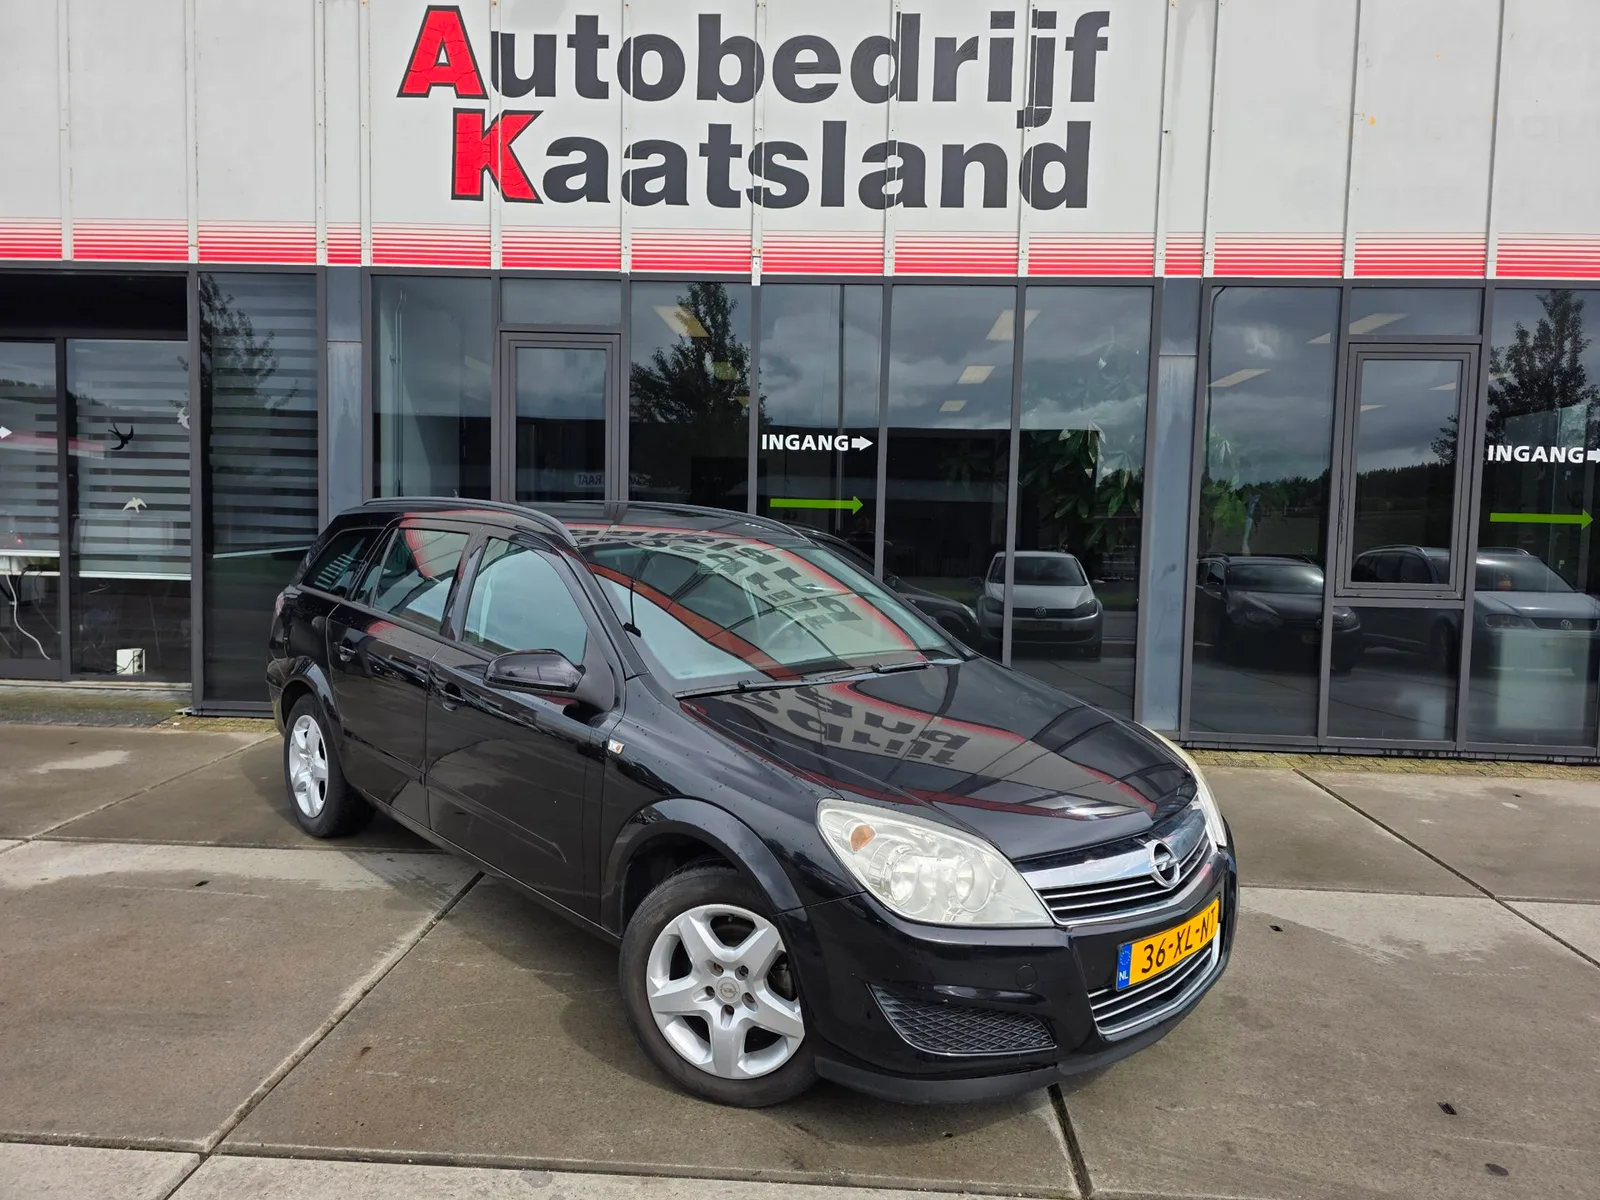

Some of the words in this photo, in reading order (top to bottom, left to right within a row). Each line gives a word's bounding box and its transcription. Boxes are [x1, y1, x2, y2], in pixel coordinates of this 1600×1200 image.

[396, 5, 1110, 128] Autobedrijf
[450, 108, 1091, 210] Kaatsland
[761, 434, 849, 451] INGANG
[1487, 445, 1584, 463] INGANG
[1141, 906, 1216, 974] 36-XL-NT
[1119, 969, 1129, 982] NL
